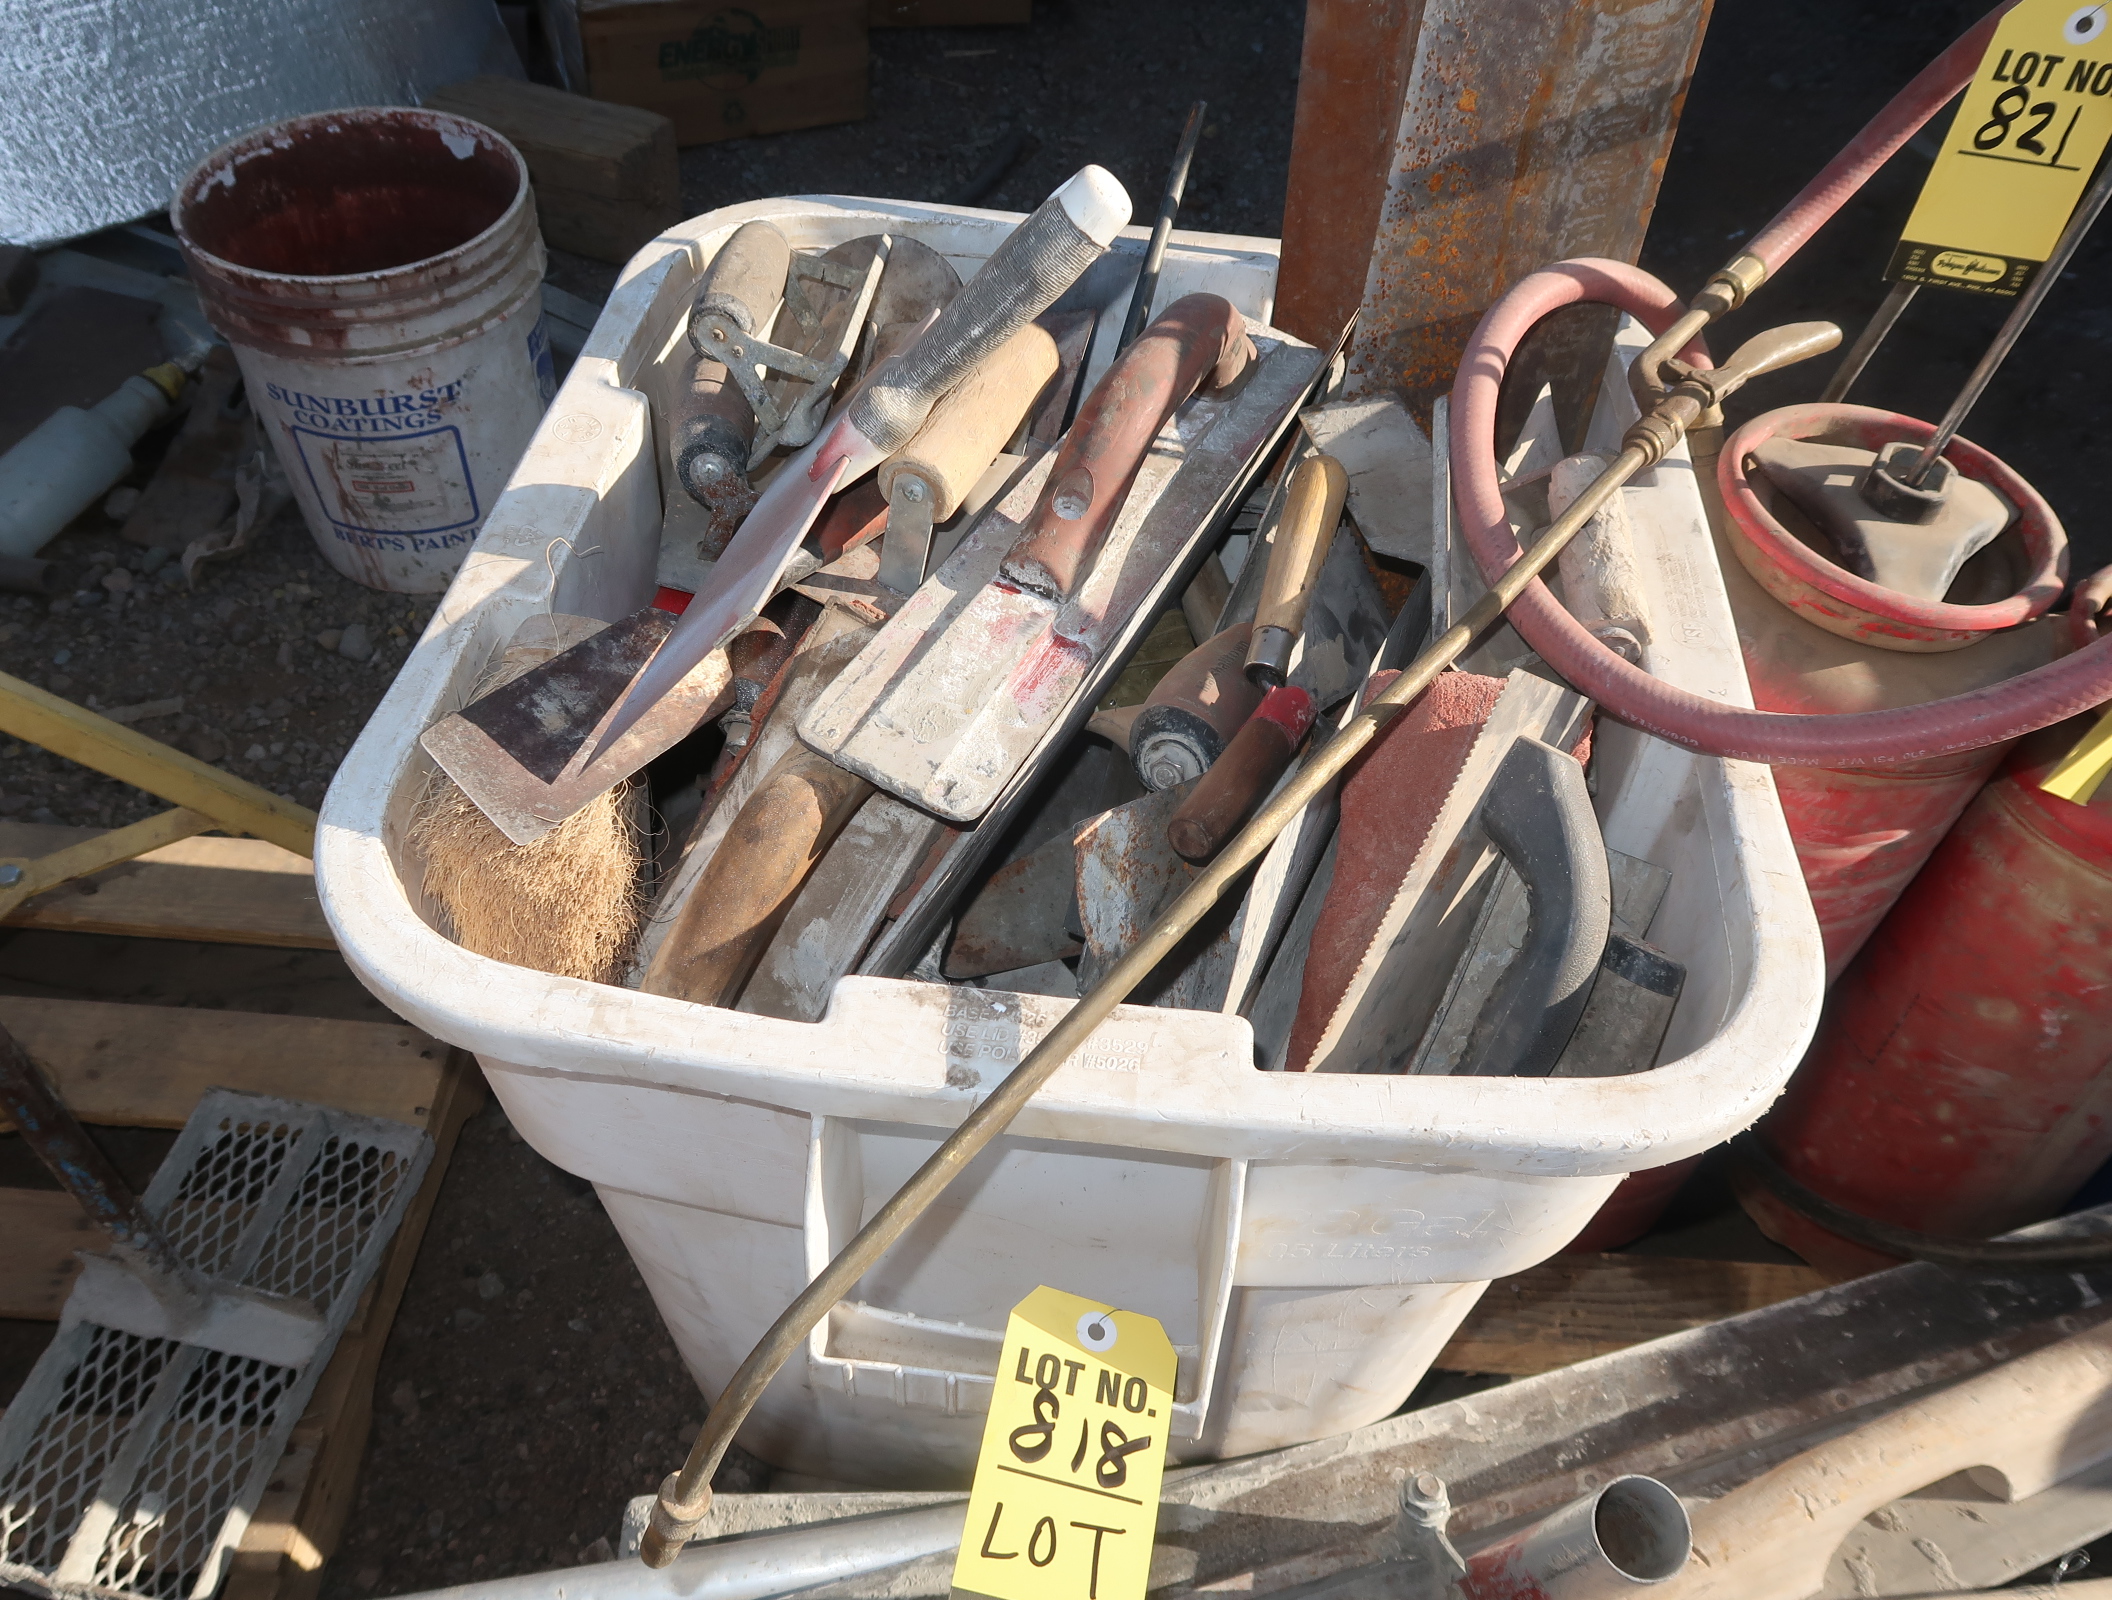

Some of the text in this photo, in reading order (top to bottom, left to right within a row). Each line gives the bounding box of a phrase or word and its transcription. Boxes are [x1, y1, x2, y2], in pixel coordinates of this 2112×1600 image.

[1992, 49, 2065, 87] LOT
[1974, 84, 2083, 166] 821
[265, 380, 463, 417] SUNBURST
[294, 408, 443, 432] COATINGS
[334, 526, 406, 552] BERT'S
[1722, 748, 1749, 760] USA
[1756, 753, 1771, 763] IN
[1778, 755, 1819, 766] MADE
[1873, 754, 1895, 764] PSI
[943, 1003, 990, 1021] BASE
[941, 1022, 979, 1039] USE
[981, 1027, 1010, 1042] LID
[938, 1040, 976, 1059] USE
[1084, 1053, 1141, 1074] #5026
[1322, 1242, 1432, 1260] Liters
[1015, 1347, 1156, 1418] LOT NO.
[1009, 1387, 1151, 1488] 818
[981, 1502, 1126, 1600] LOT
